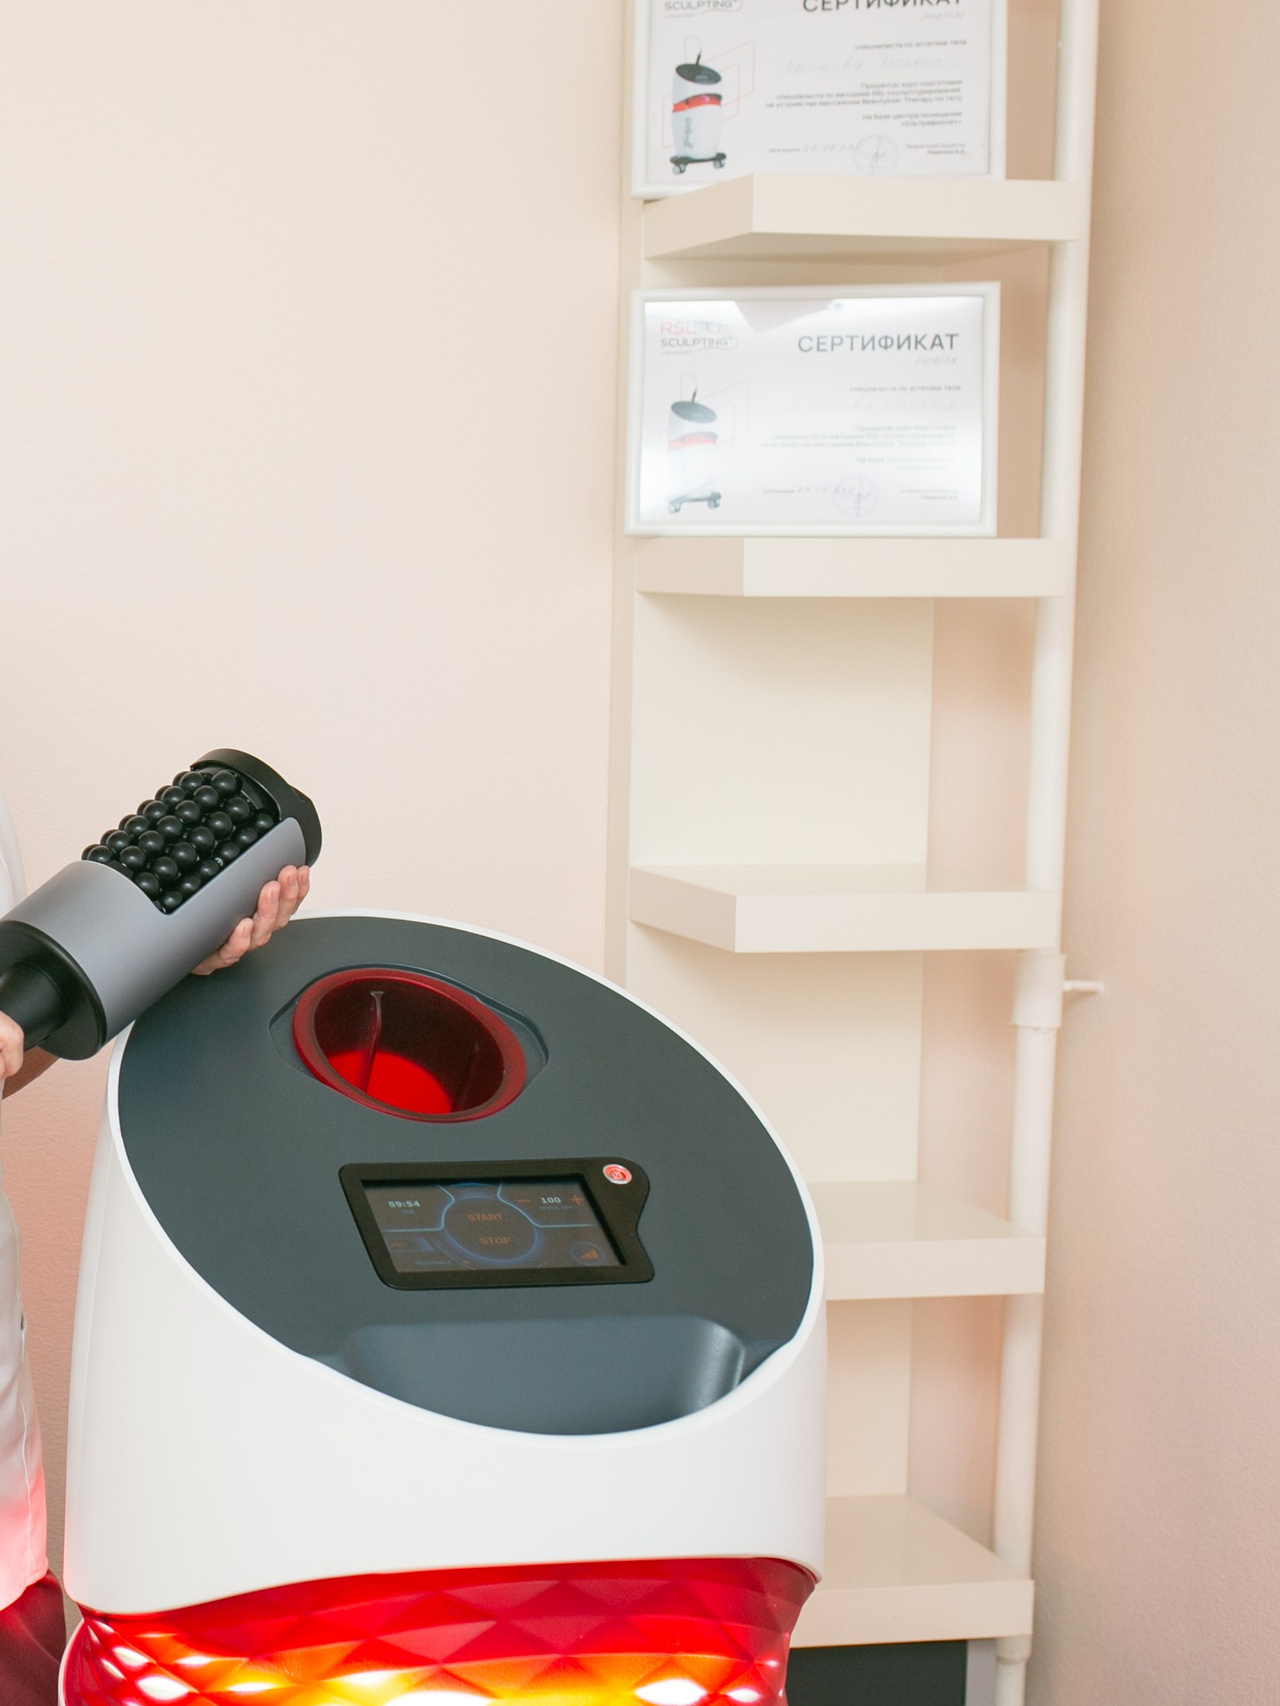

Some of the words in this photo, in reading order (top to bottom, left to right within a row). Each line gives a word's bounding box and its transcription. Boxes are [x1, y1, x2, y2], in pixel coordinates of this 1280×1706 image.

[798, 334, 959, 352] СЕРТИФИКАТ
[388, 1200, 420, 1208] 59:54
[541, 1196, 561, 1204] 100
[468, 1212, 503, 1222] START
[479, 1236, 511, 1245] STOP
